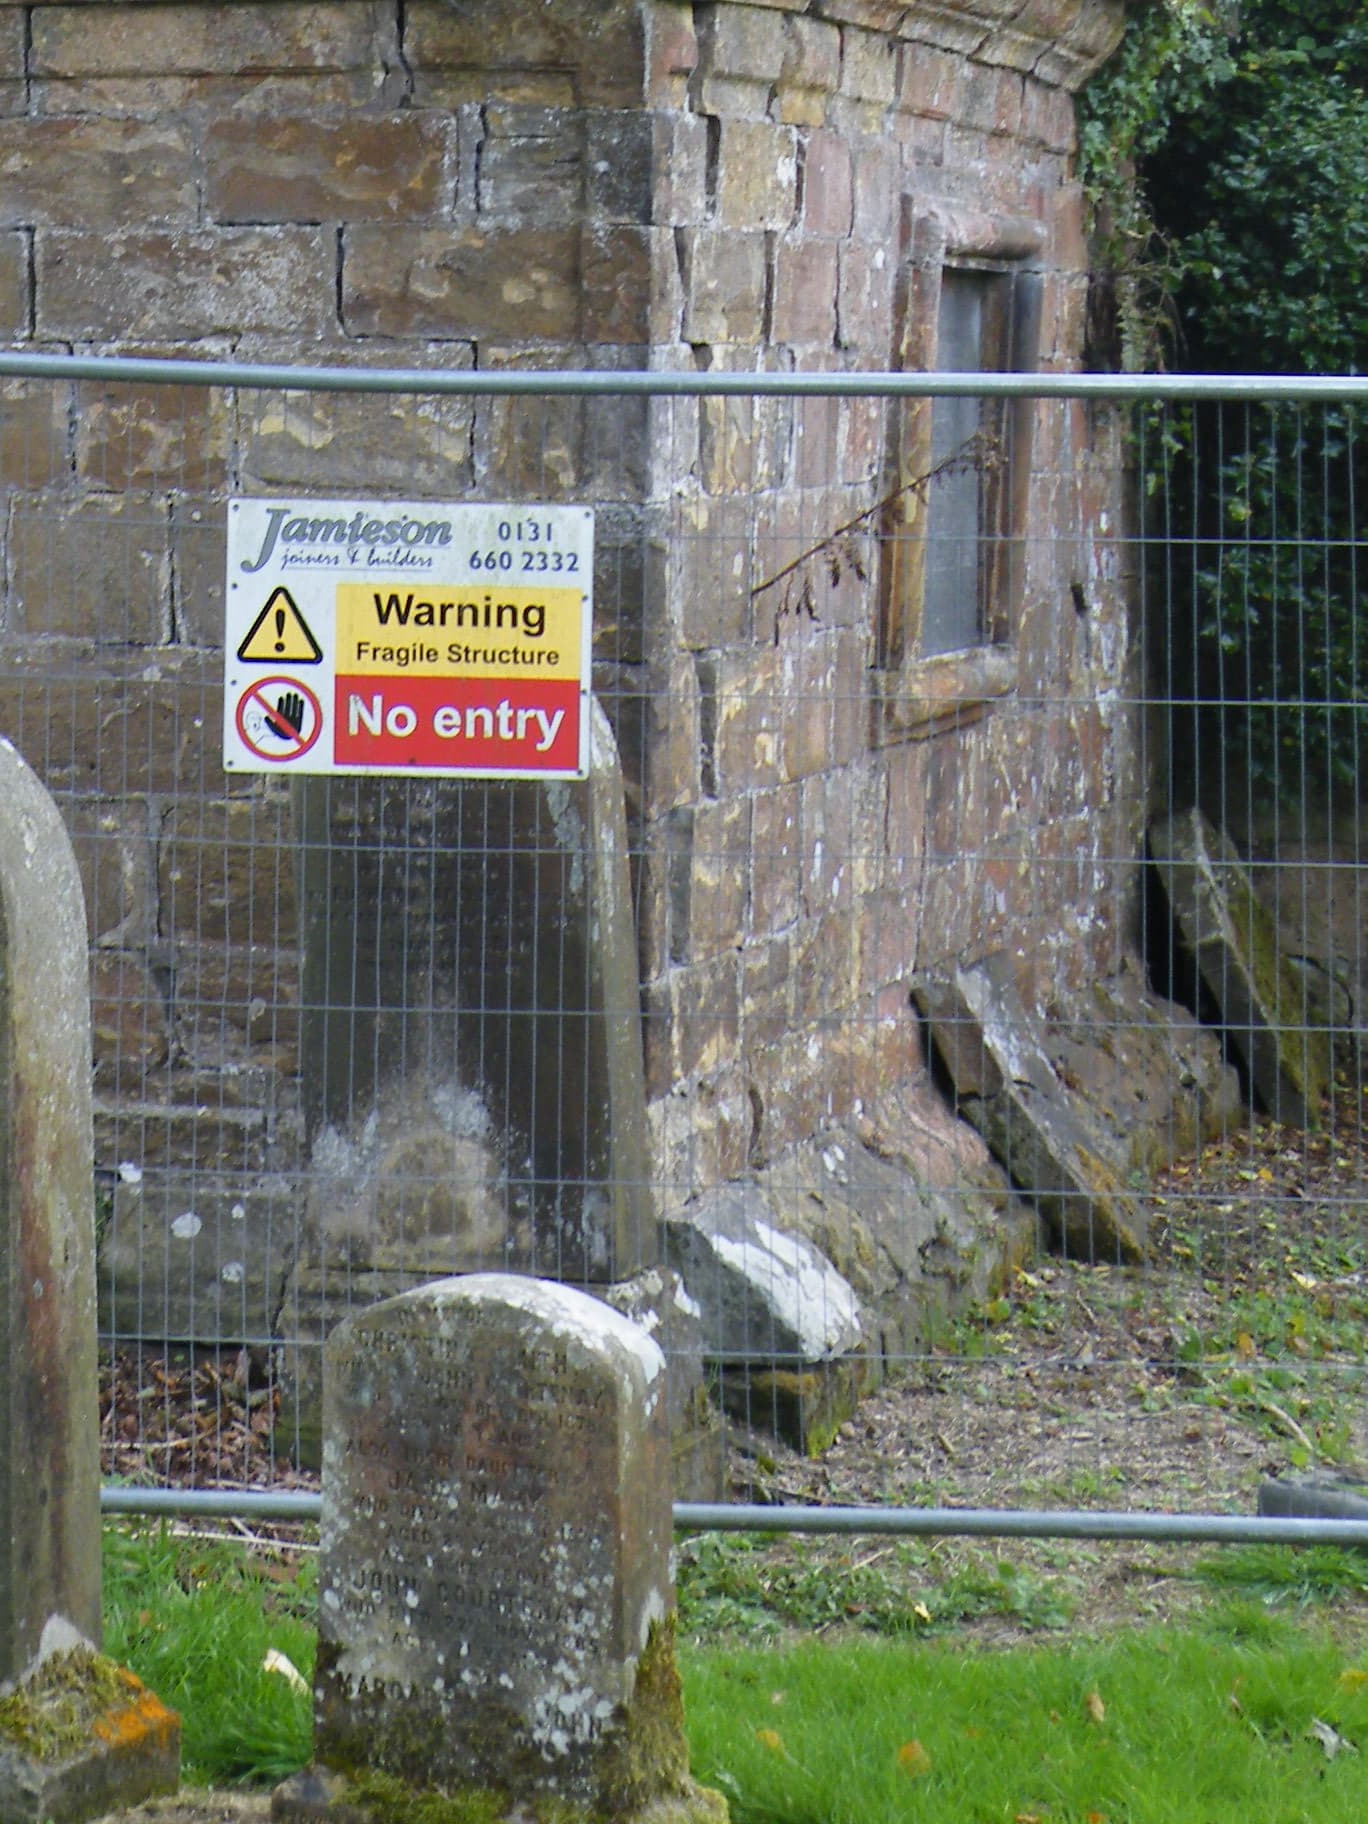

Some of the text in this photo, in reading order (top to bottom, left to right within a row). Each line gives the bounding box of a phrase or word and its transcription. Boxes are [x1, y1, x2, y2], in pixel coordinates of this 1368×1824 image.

[240, 508, 453, 573] Jamieson
[498, 522, 553, 542] 0131
[280, 547, 339, 571] joiners
[367, 547, 432, 567] builders
[469, 551, 579, 572] 660 2332
[374, 593, 546, 637] Warning
[357, 642, 559, 667] Fragile Structure
[348, 694, 565, 752] No entry
